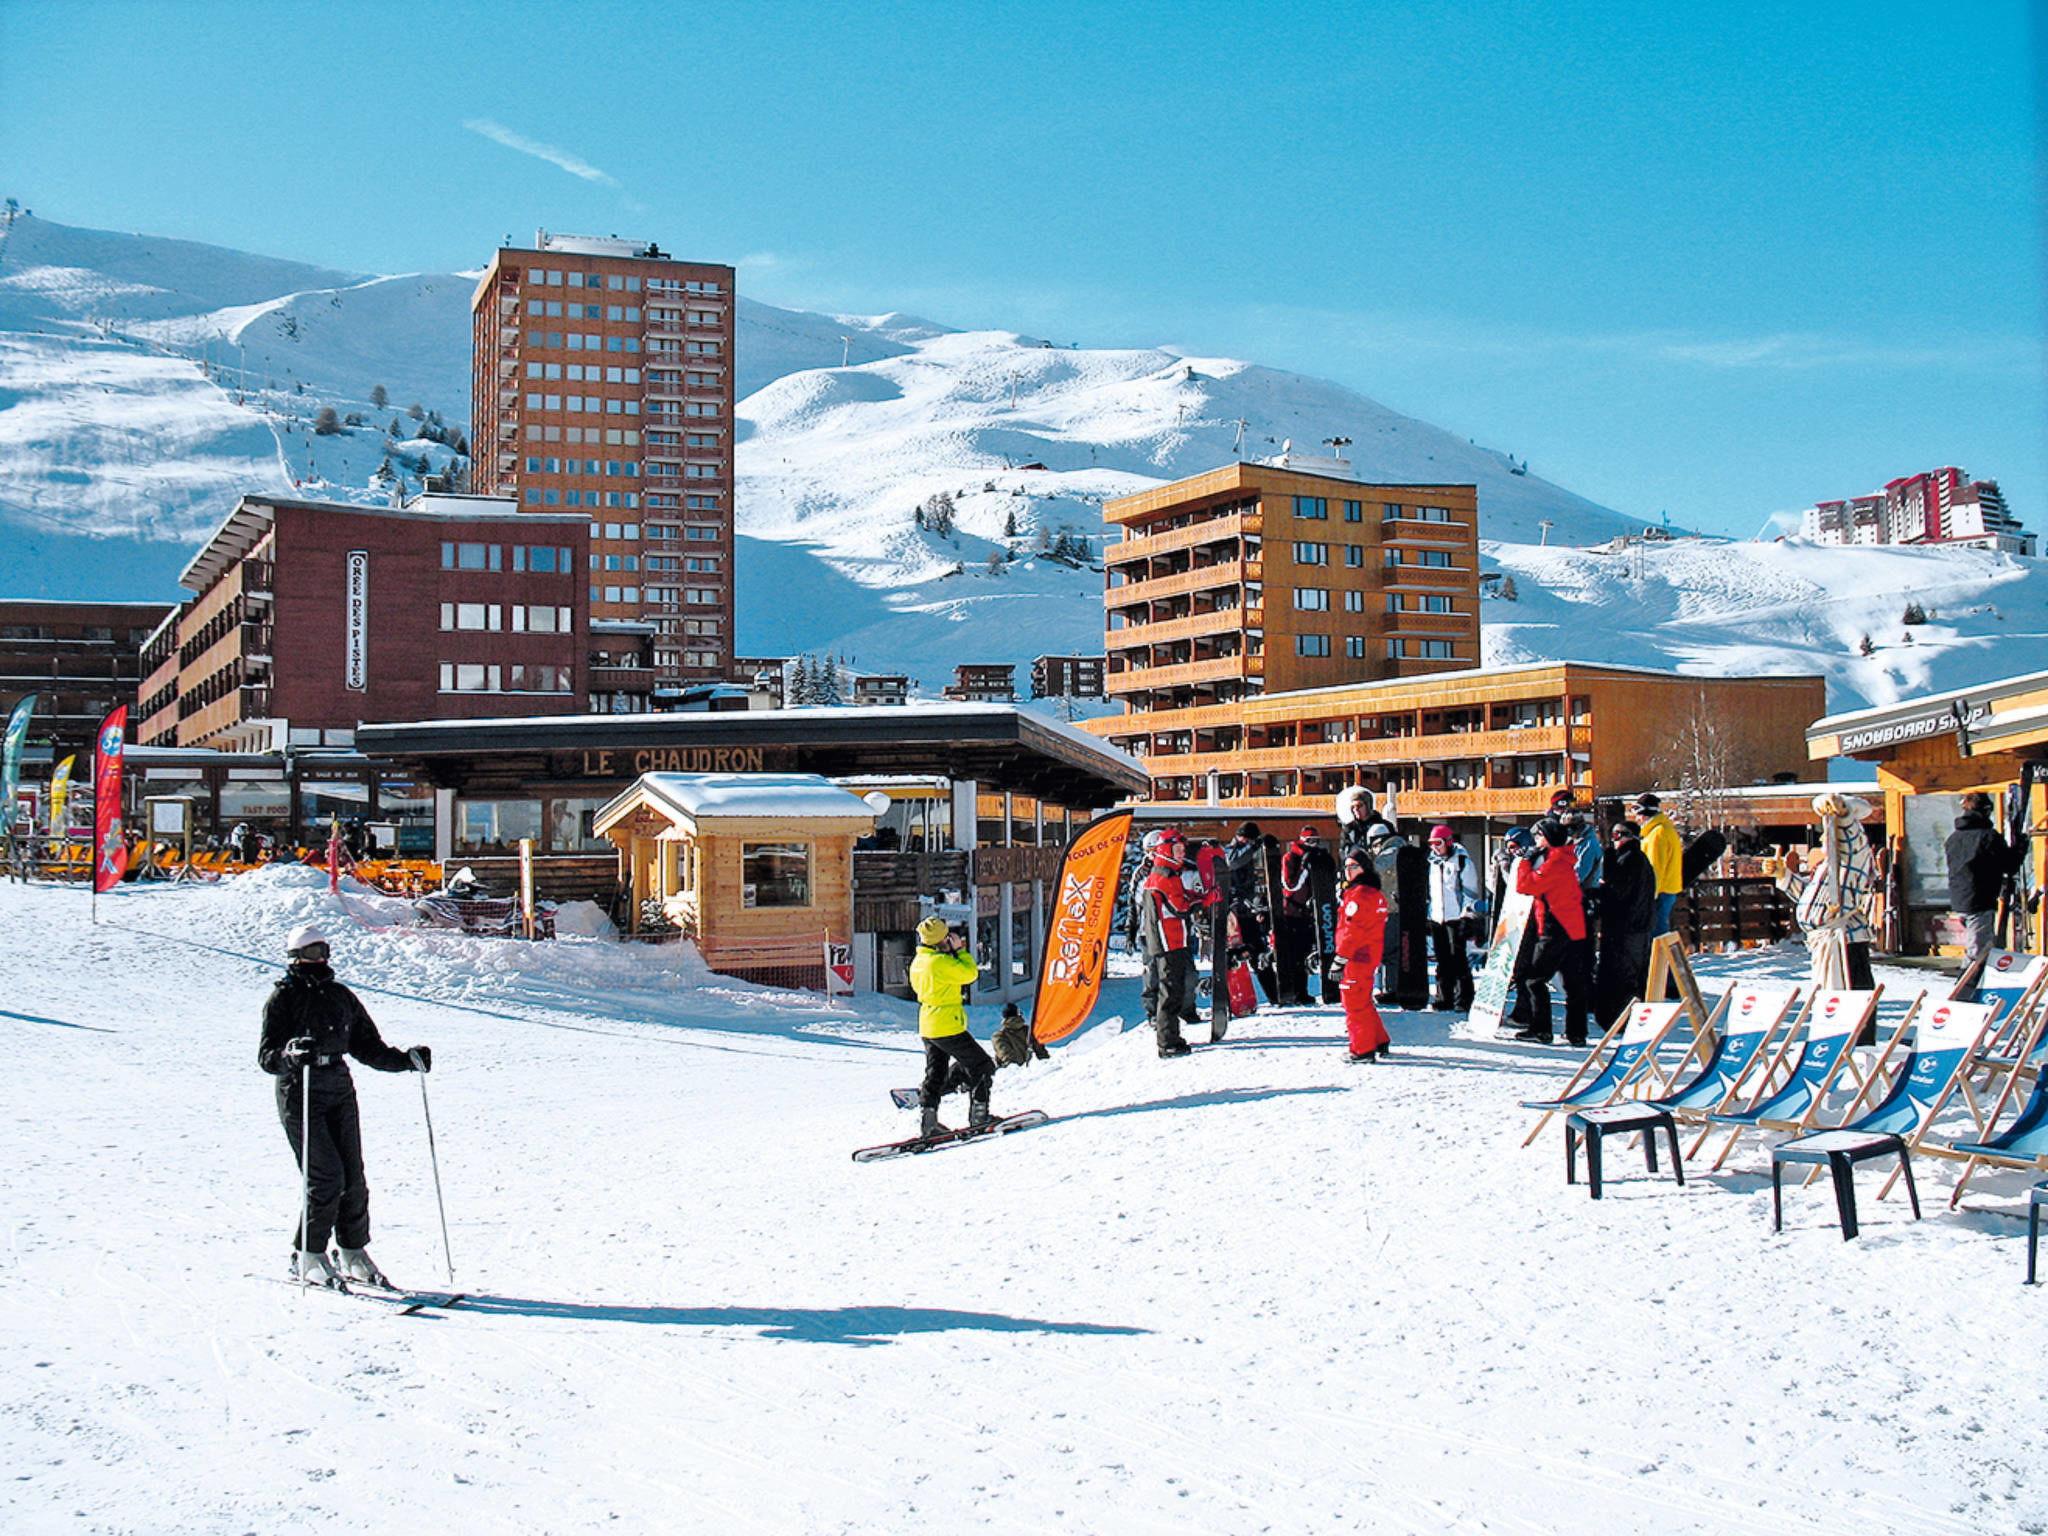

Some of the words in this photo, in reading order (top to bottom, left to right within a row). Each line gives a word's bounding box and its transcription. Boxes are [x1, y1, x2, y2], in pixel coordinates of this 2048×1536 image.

[353, 600, 361, 627] DES
[352, 629, 361, 686] PISTES
[1843, 717, 1937, 750] SNOWBOARD
[584, 751, 615, 775] LE
[635, 748, 763, 772] CHAUDRON
[266, 806, 288, 814] FOOD
[1097, 841, 1108, 850] DE
[1089, 876, 1105, 928] School
[1321, 903, 1335, 954] burton
